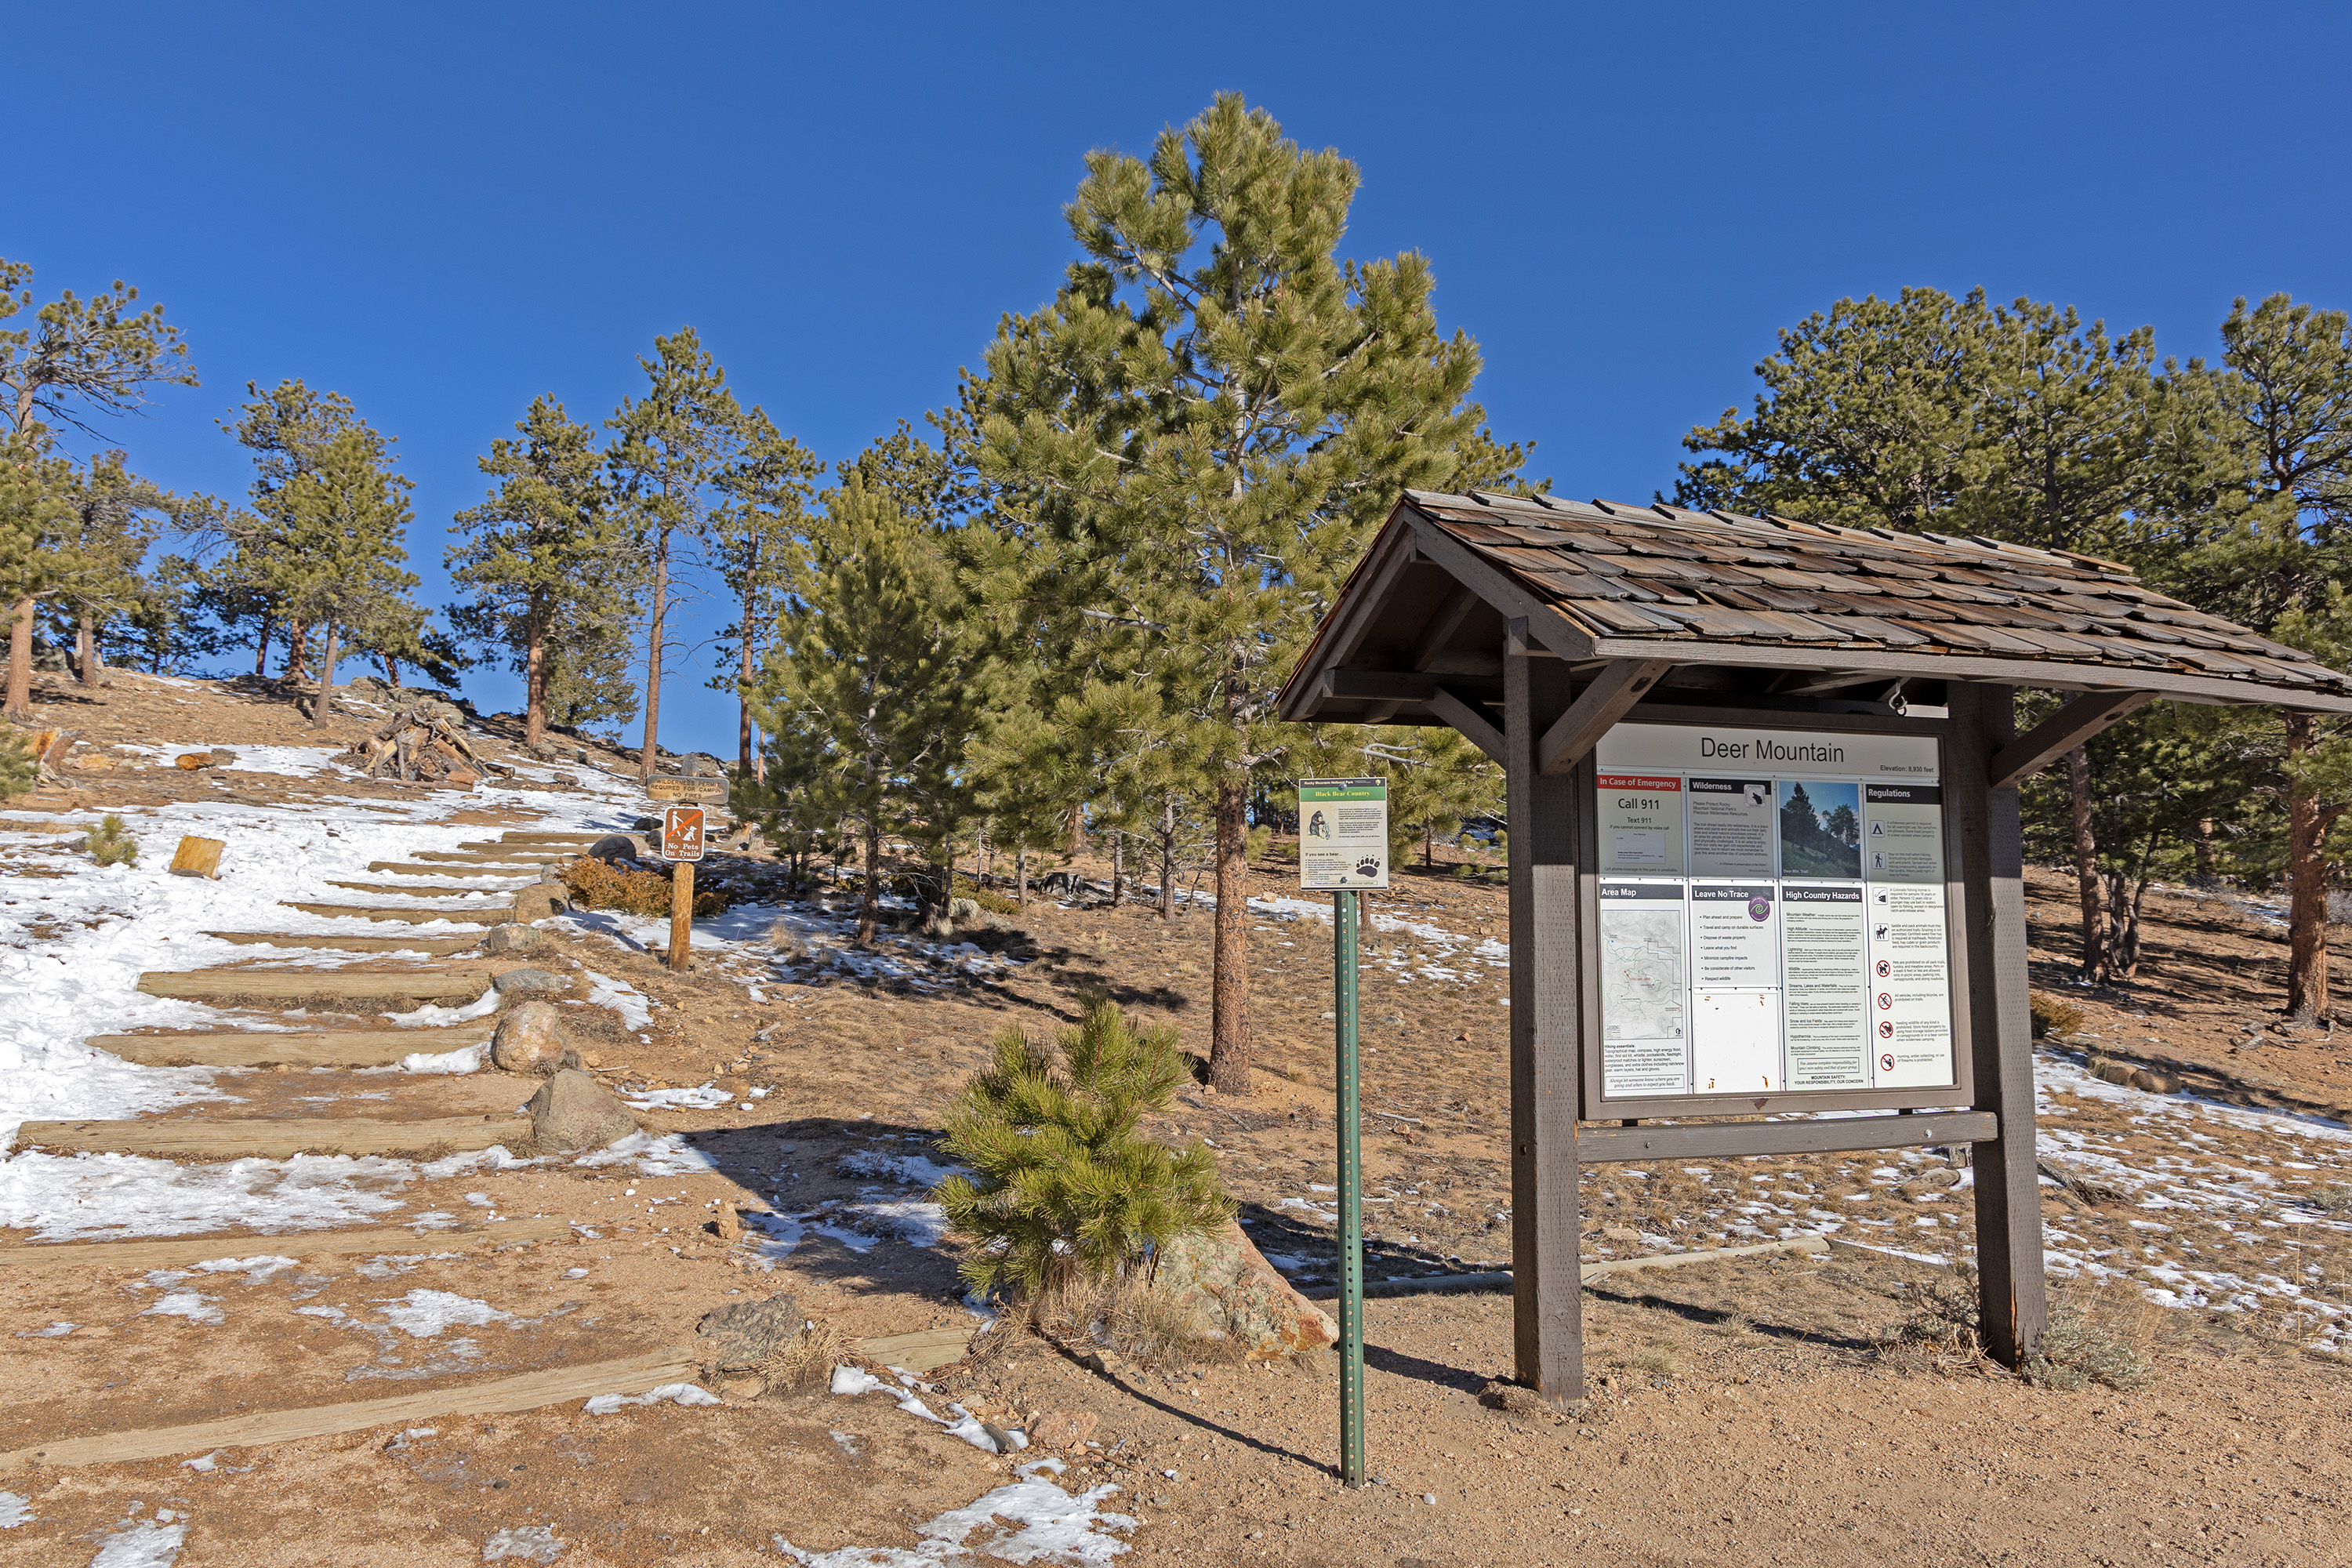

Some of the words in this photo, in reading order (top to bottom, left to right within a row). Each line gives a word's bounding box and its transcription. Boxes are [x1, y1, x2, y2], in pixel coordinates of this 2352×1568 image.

[1701, 737, 1749, 758] Deer
[1756, 739, 1844, 762] Mountain
[1637, 779, 1676, 789] Emergency
[1693, 782, 1732, 790] Wilderness
[1868, 789, 1911, 799] Regulations
[1618, 798, 1638, 809] Call
[1641, 799, 1659, 809] 911
[1621, 888, 1636, 898] Map
[1786, 891, 1802, 900] High
[1803, 891, 1831, 900] Country
